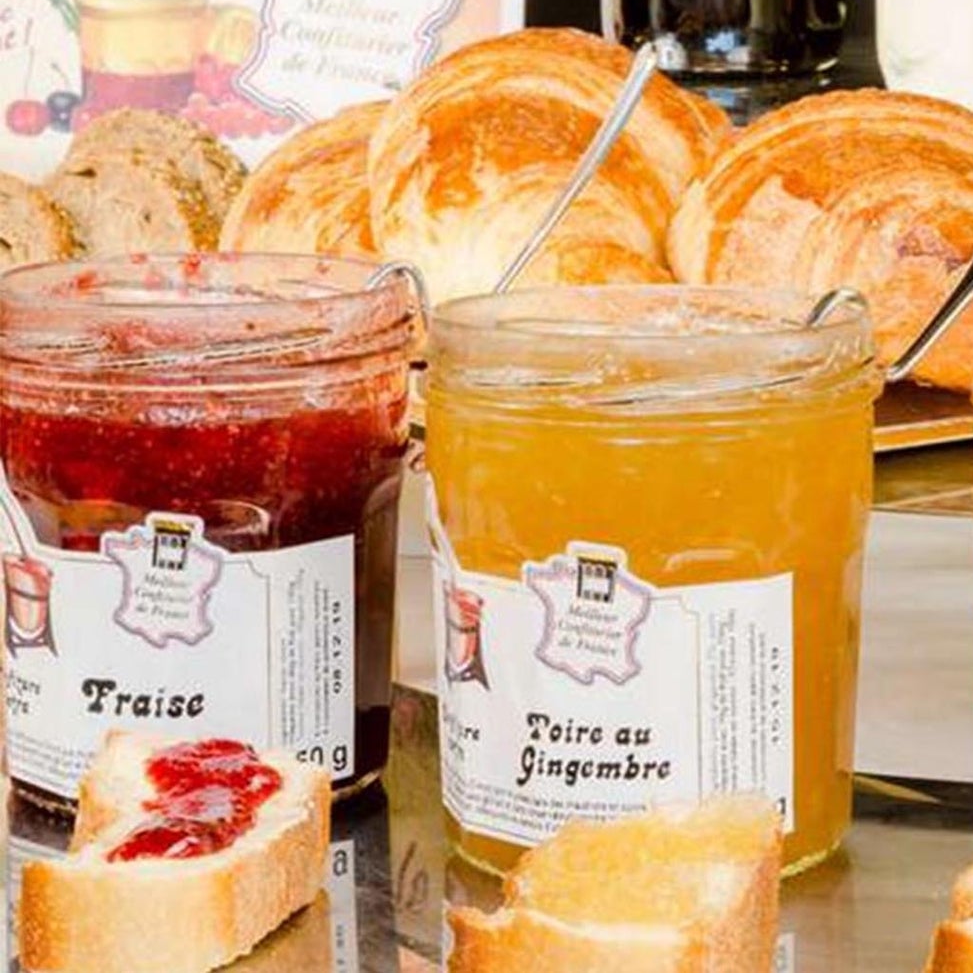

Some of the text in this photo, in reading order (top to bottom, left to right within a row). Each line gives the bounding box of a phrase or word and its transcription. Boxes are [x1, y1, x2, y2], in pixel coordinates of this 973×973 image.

[81, 677, 205, 718] Fraise
[526, 711, 652, 745] Poire au
[332, 744, 348, 772] g
[516, 746, 672, 786] Gingembre
